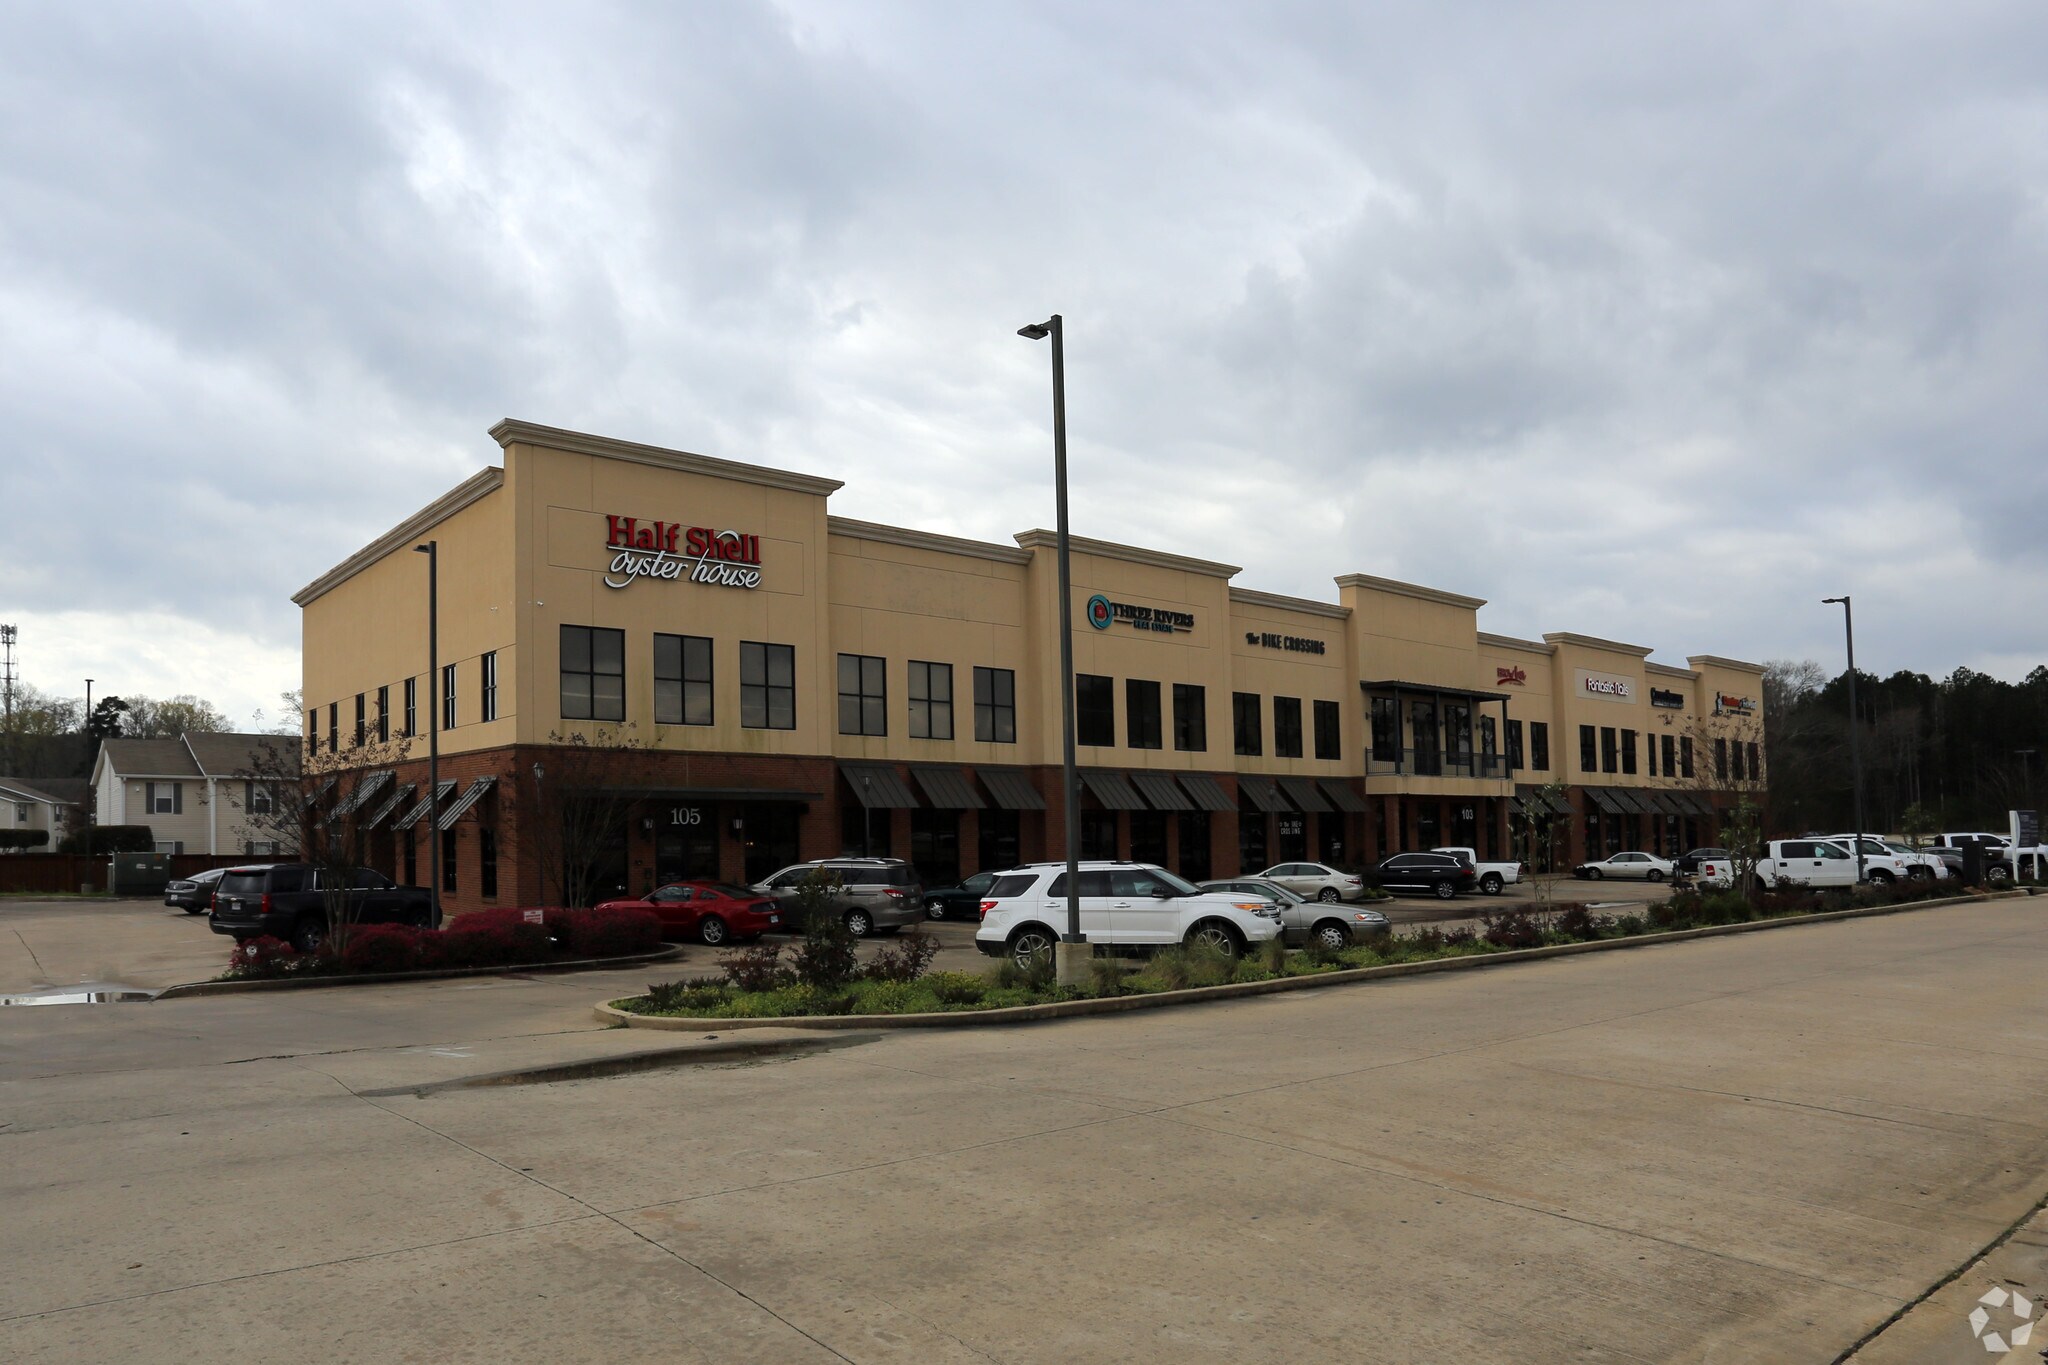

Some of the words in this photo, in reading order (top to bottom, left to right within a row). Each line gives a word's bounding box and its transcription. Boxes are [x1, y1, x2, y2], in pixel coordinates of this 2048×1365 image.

[606, 514, 680, 553] Half
[686, 526, 761, 564] Shell
[691, 548, 761, 588] house
[1111, 602, 1153, 620] THREE
[1153, 608, 1194, 627] RIVERS
[1245, 632, 1260, 645] The
[1261, 632, 1282, 650] BIKE
[1284, 636, 1325, 655] CROSSING
[671, 808, 701, 825] 105
[1462, 809, 1474, 820] 103
